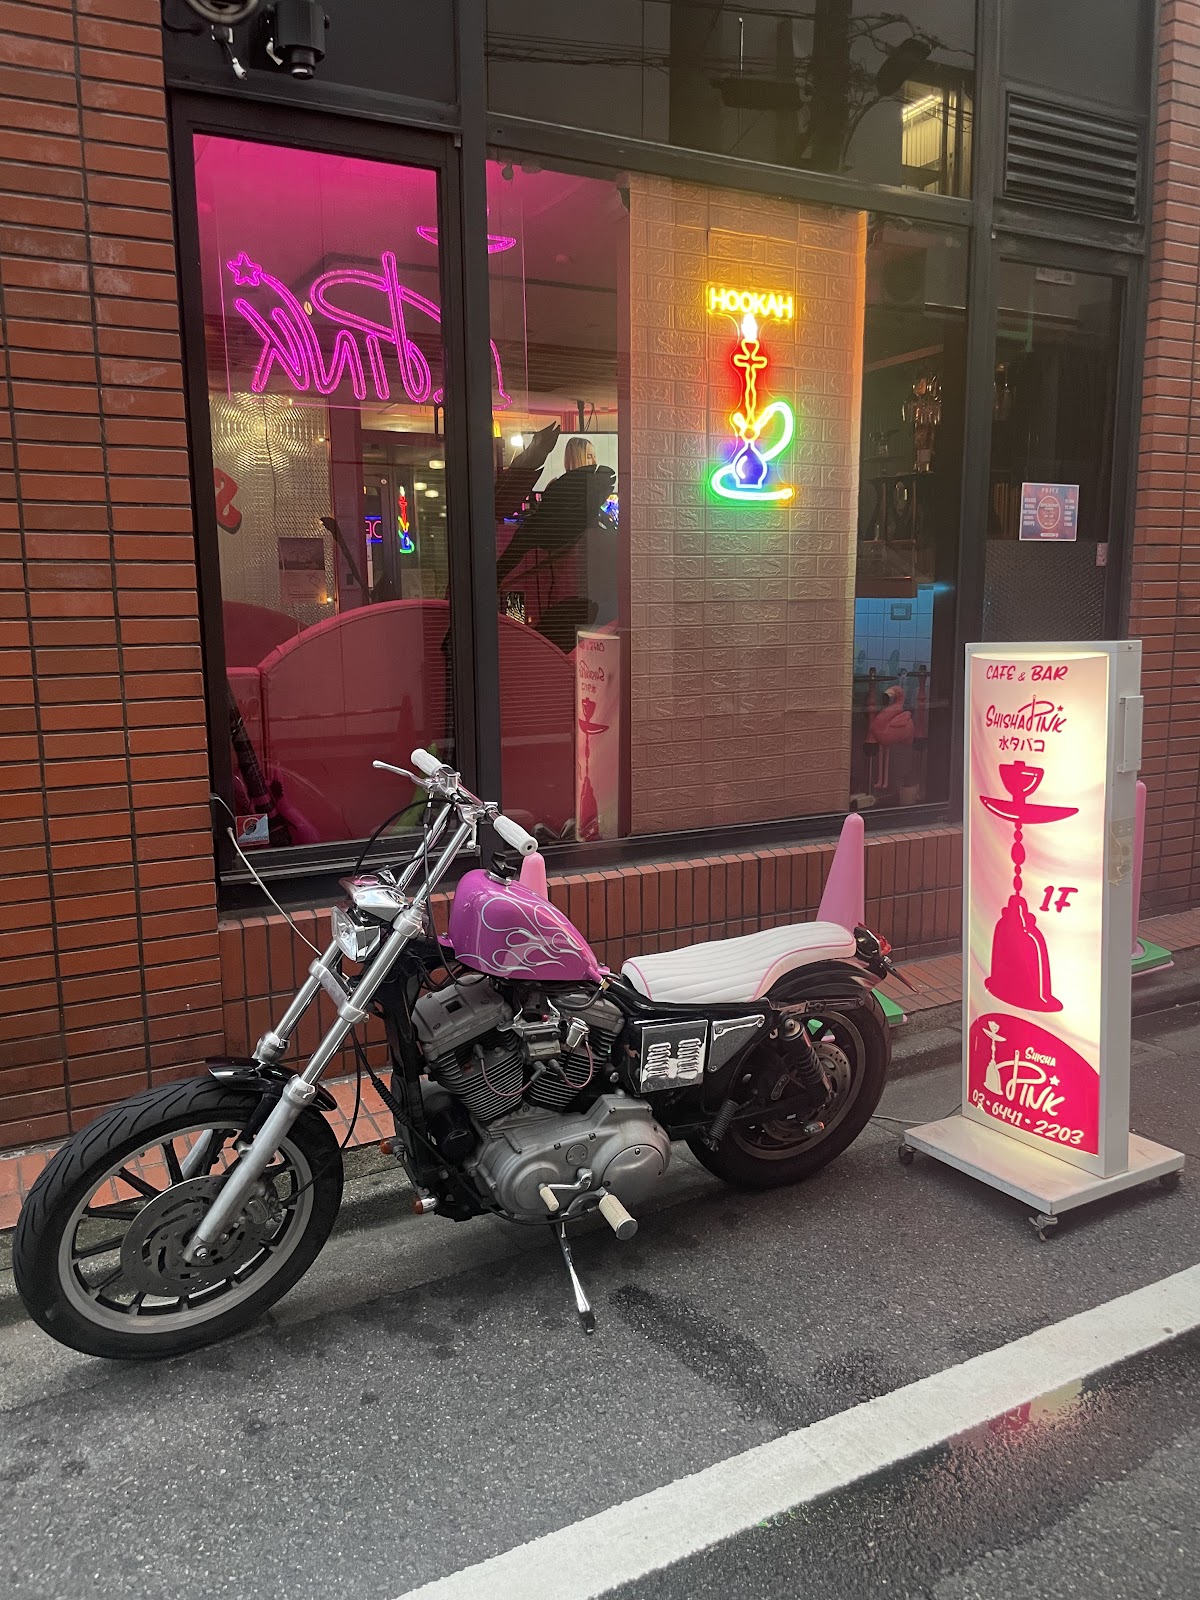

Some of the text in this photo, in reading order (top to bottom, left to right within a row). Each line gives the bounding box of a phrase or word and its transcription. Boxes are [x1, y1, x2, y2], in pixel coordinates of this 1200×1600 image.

[709, 287, 794, 319] HOOKAH
[986, 665, 1068, 681] CAFE & BAR
[998, 735, 1046, 753] 水タバコ
[1039, 885, 1079, 913] 1F
[996, 1050, 1065, 1116] PINK
